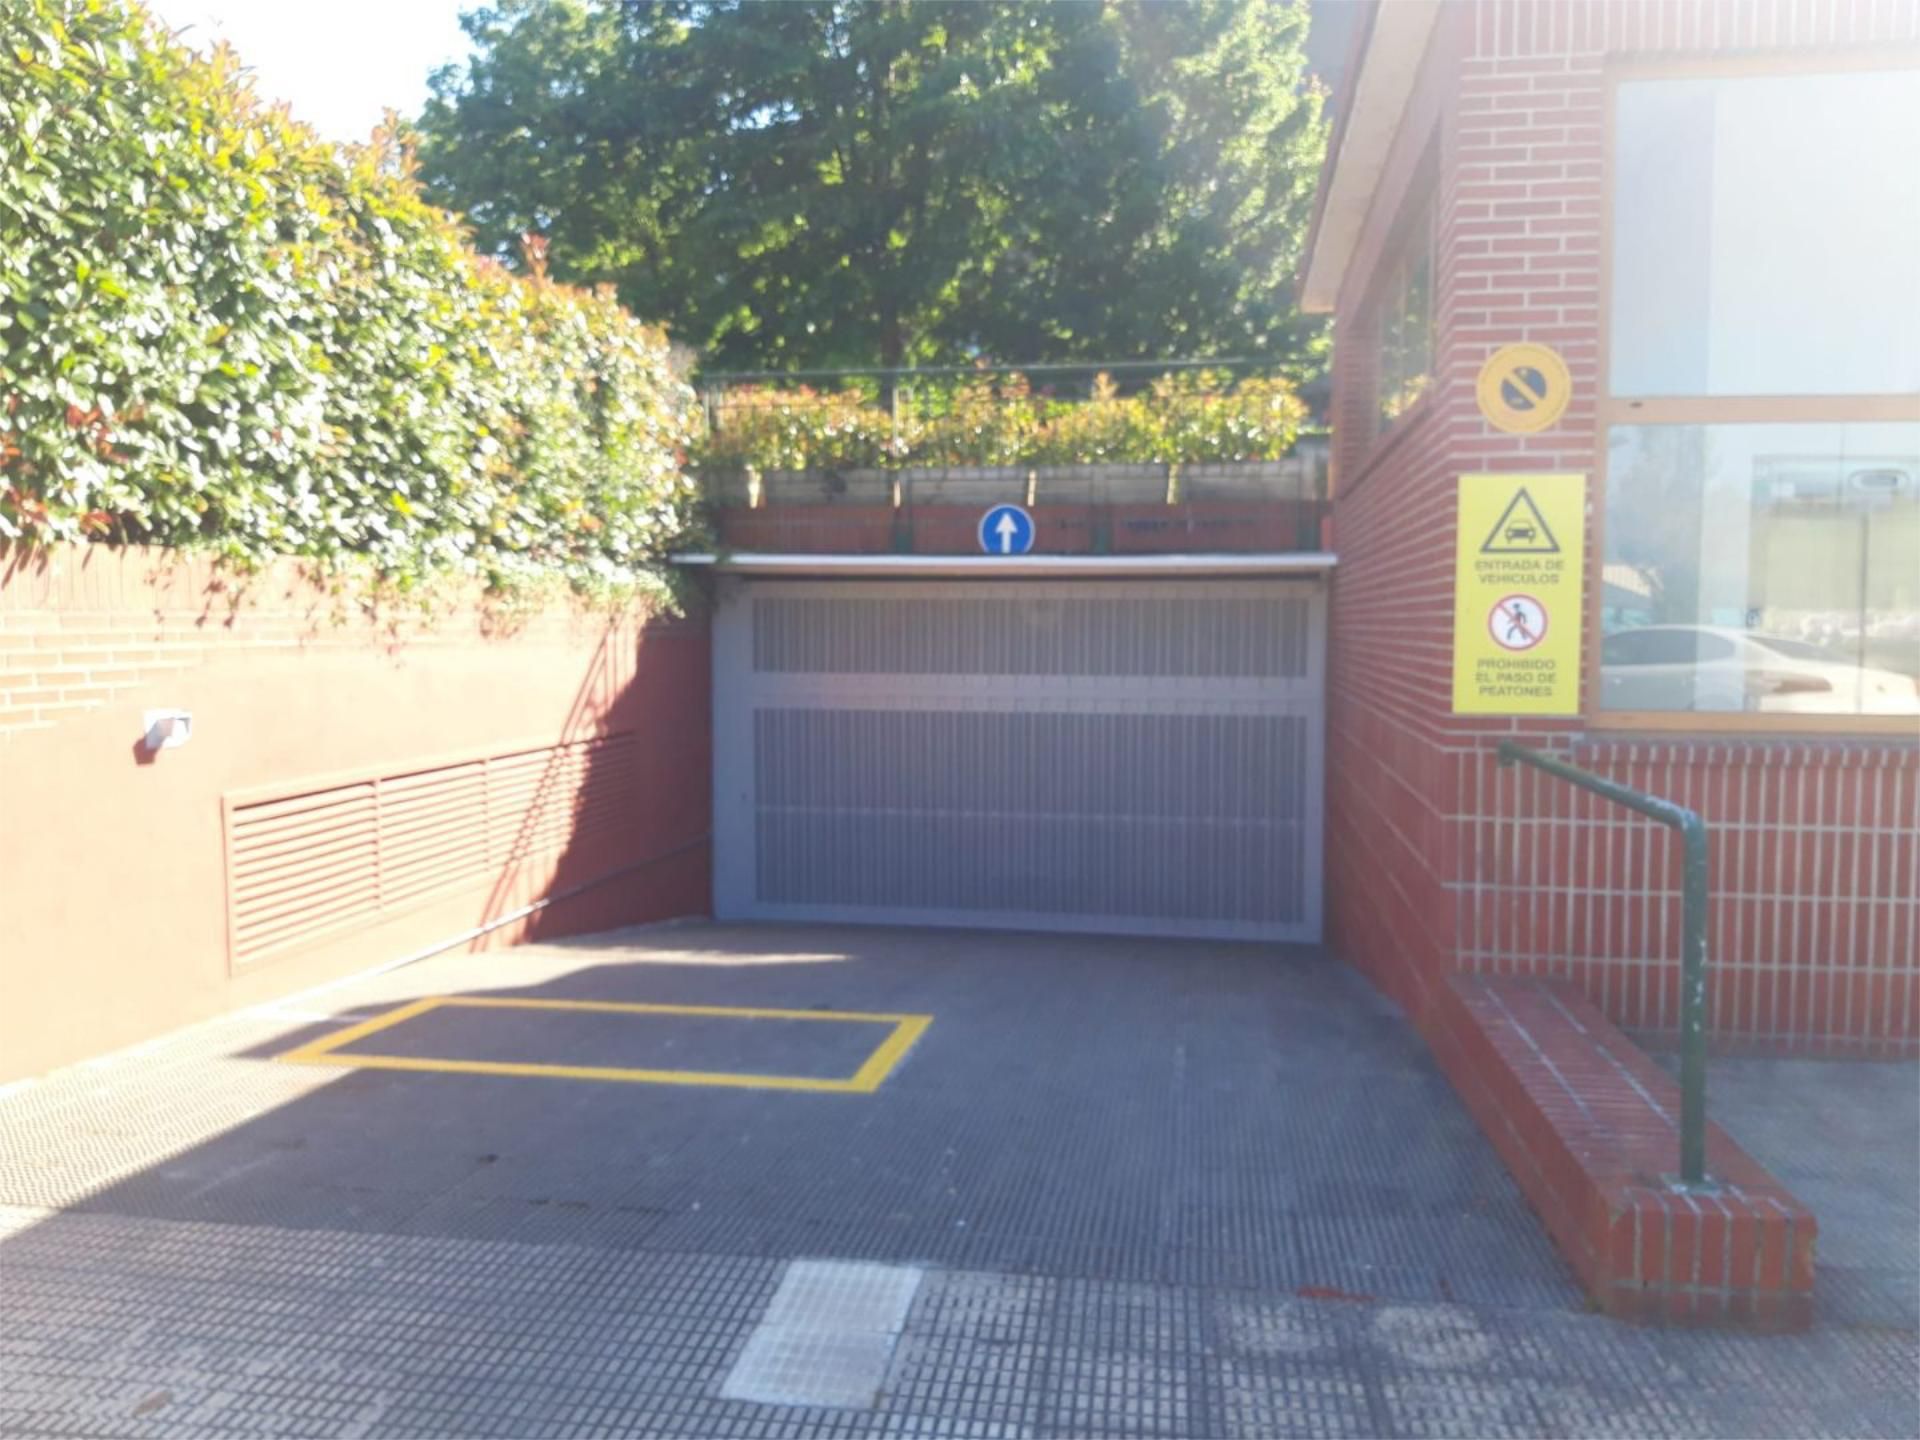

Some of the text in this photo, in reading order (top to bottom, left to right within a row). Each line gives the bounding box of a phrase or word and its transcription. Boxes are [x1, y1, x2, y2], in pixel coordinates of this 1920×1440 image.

[1475, 560, 1564, 571] ENTRADA DE
[1477, 658, 1556, 670] PROHIBIDO
[1476, 672, 1556, 683] EL PASO DE
[1479, 685, 1553, 697] PEATONES
